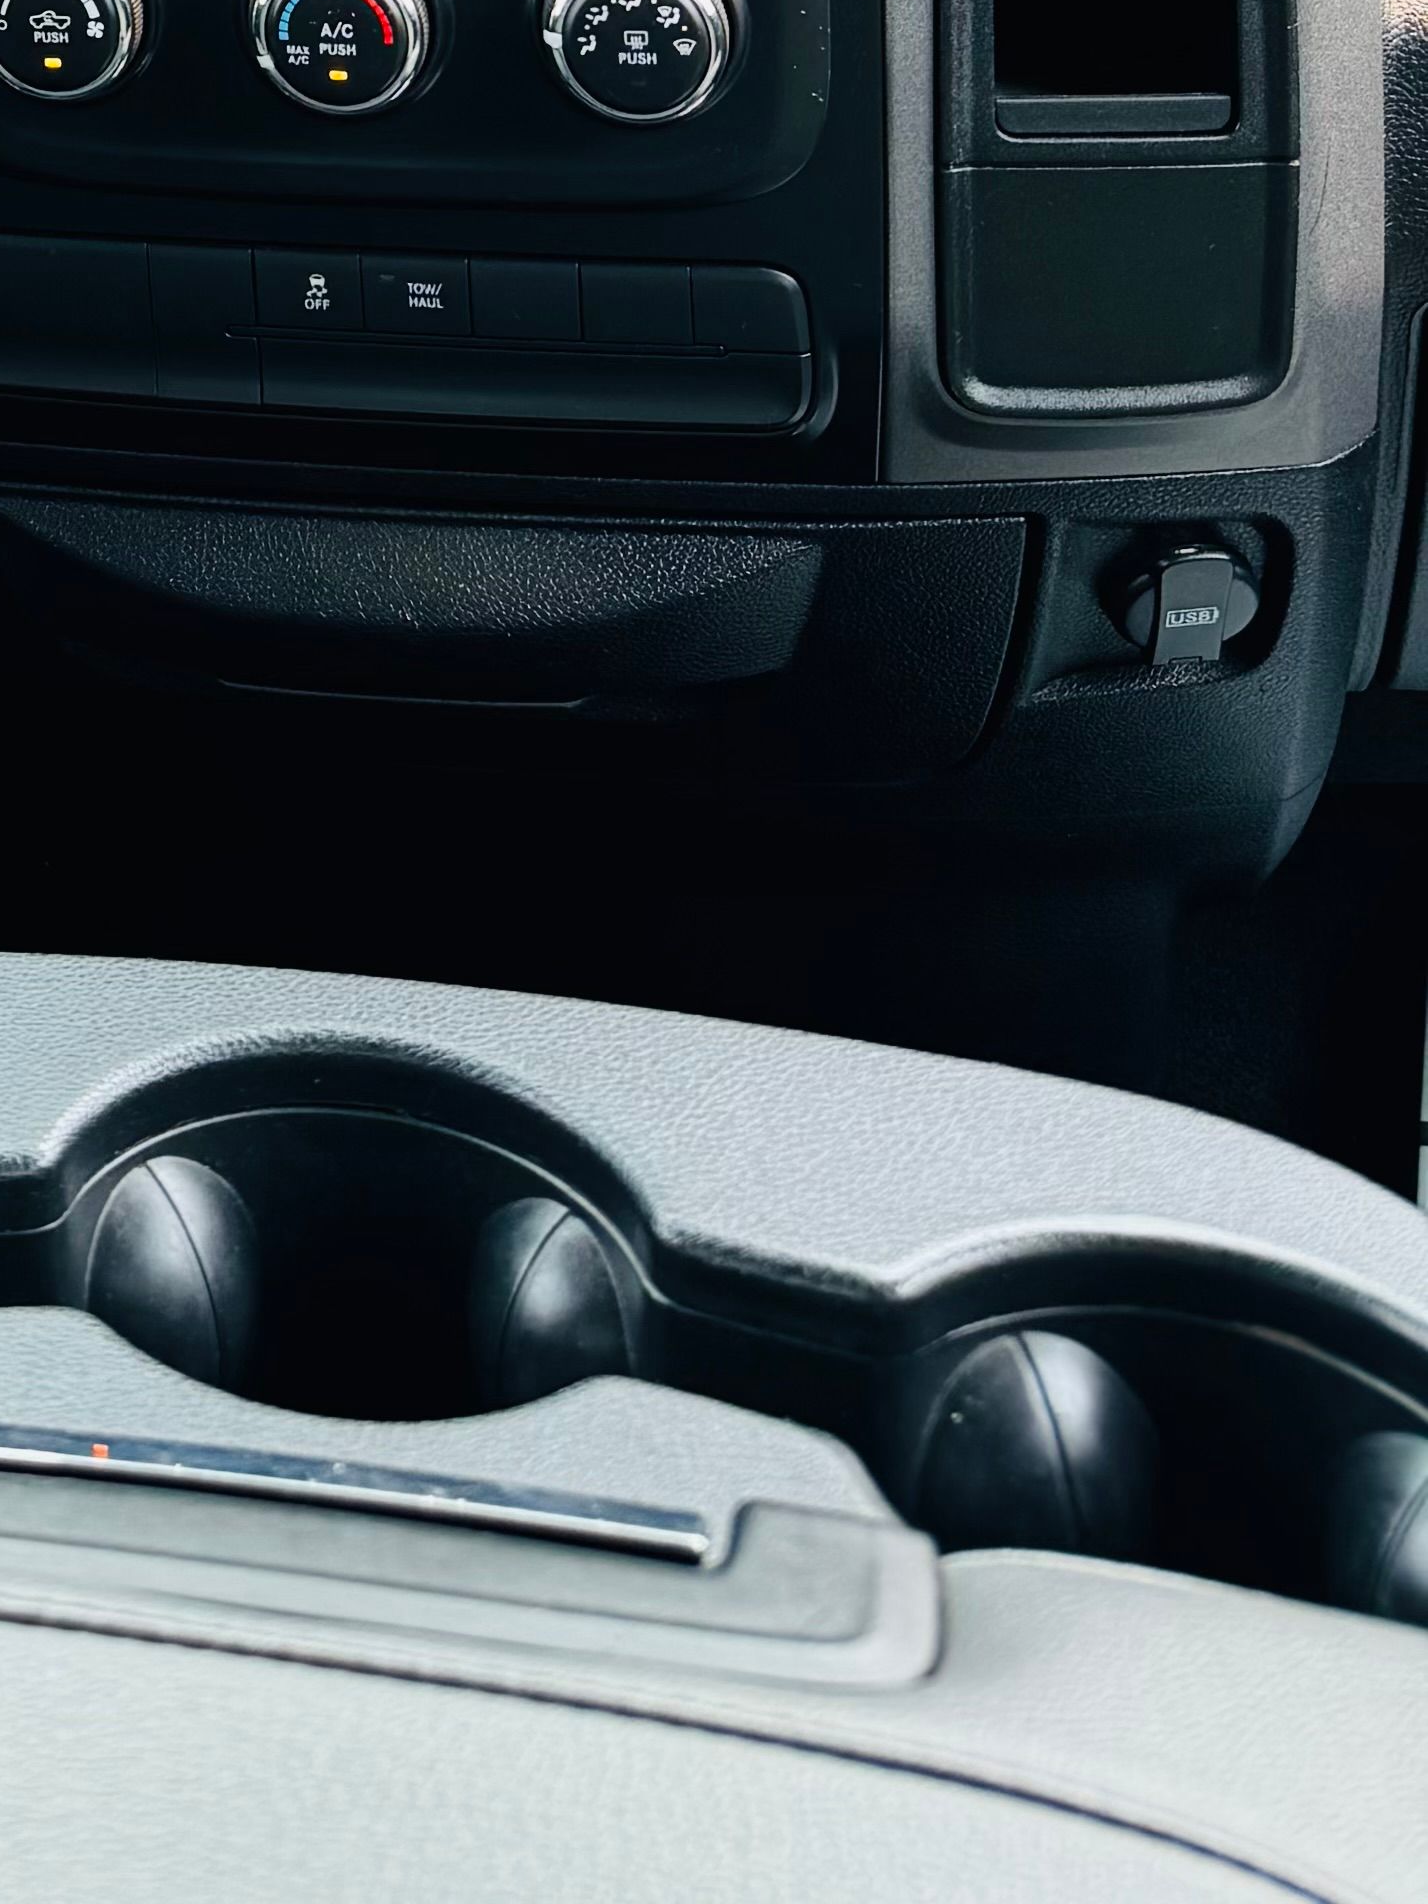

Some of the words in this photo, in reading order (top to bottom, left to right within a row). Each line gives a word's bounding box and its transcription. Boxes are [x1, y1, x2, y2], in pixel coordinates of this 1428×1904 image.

[33, 29, 69, 44] PUSH
[320, 21, 354, 40] A/C
[318, 42, 357, 56] PUSH
[617, 51, 658, 66] PUSH
[406, 281, 443, 295] TOW/
[304, 296, 331, 310] OFF
[408, 295, 444, 309] HAUL
[1170, 610, 1211, 625] USB
